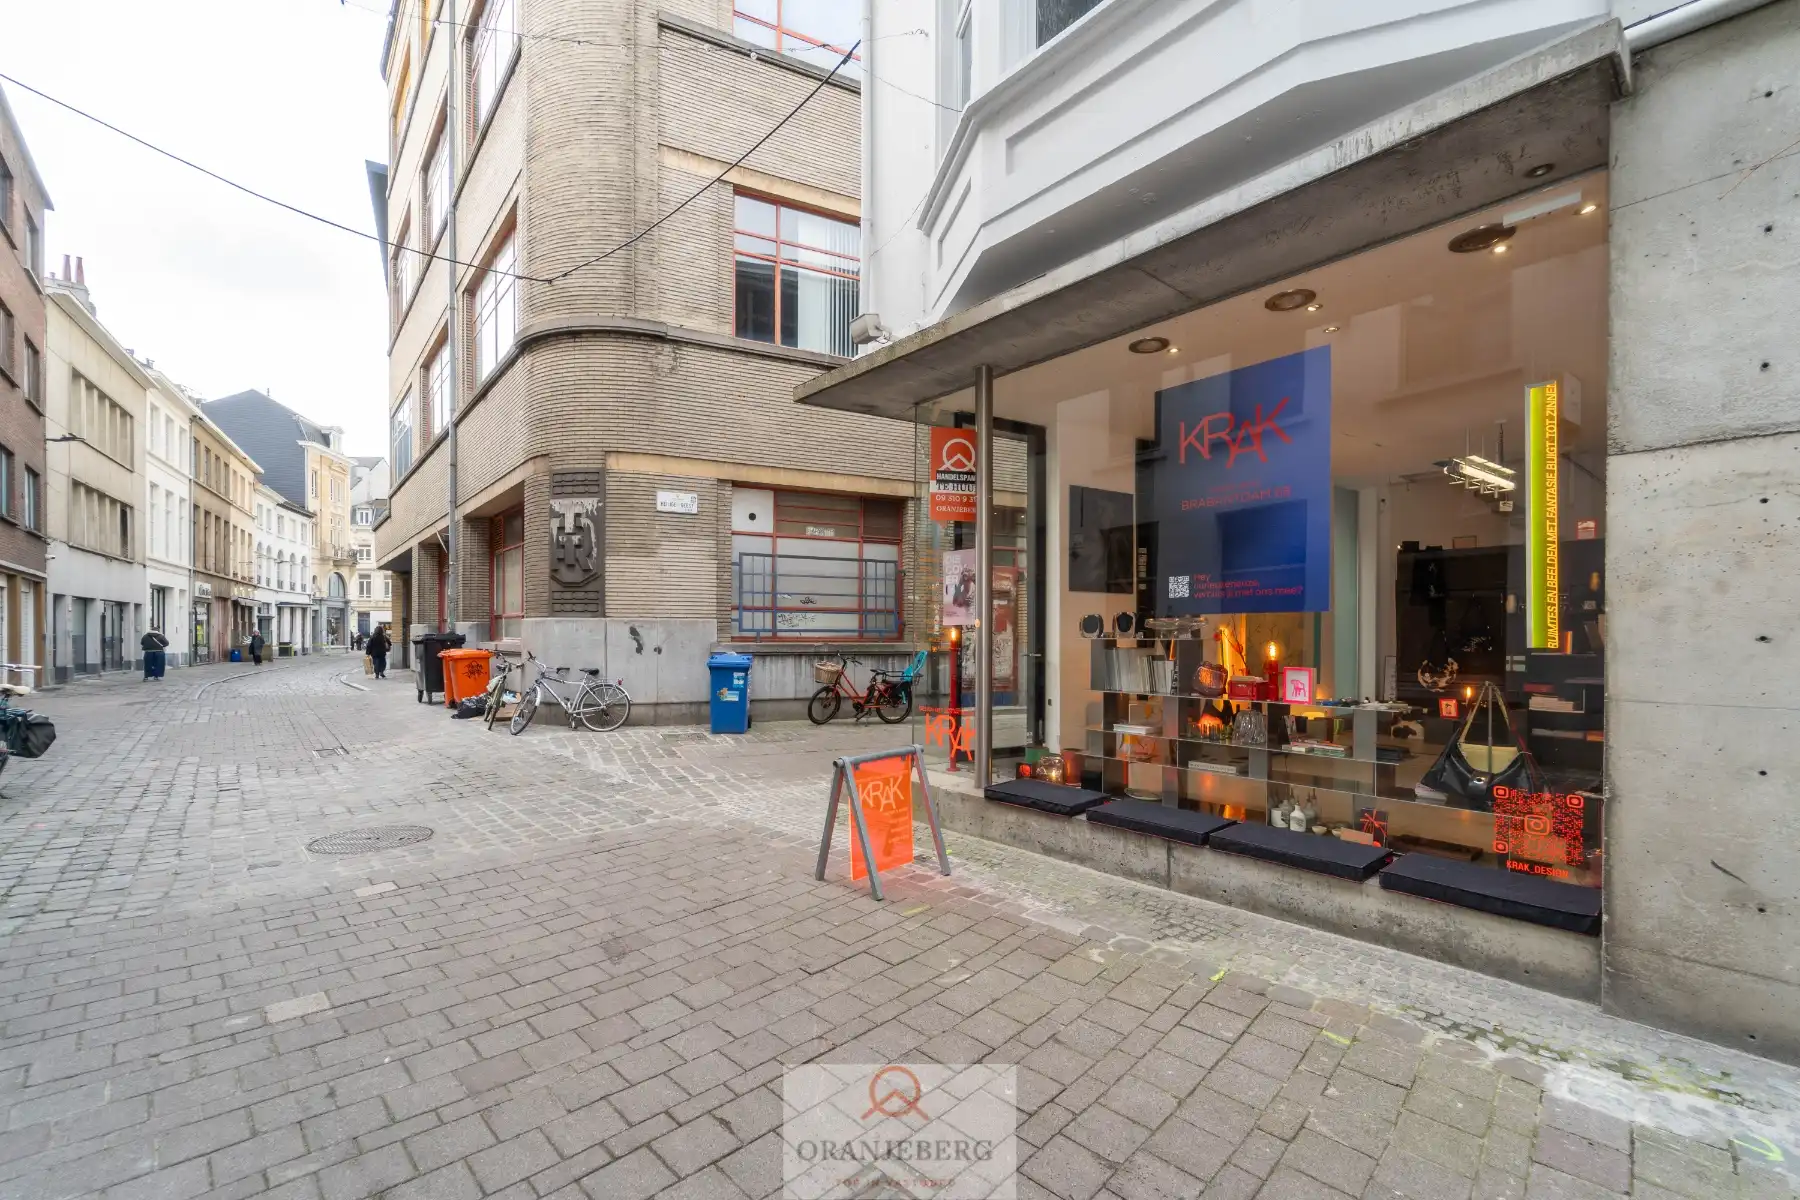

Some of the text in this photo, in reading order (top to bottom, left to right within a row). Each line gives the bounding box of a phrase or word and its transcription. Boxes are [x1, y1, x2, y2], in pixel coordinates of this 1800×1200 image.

[1179, 396, 1294, 469] KRAK
[1545, 419, 1556, 439] TOT
[1546, 441, 1556, 470] BUIGT
[1546, 473, 1557, 518] FANTASIE
[1546, 519, 1557, 541] MET
[1547, 543, 1558, 587] BEELDEN
[1255, 588, 1273, 596] ons
[1547, 590, 1558, 604] EN
[859, 776, 905, 812] KRAK
[1506, 860, 1569, 879] KRAK_DESIGN
